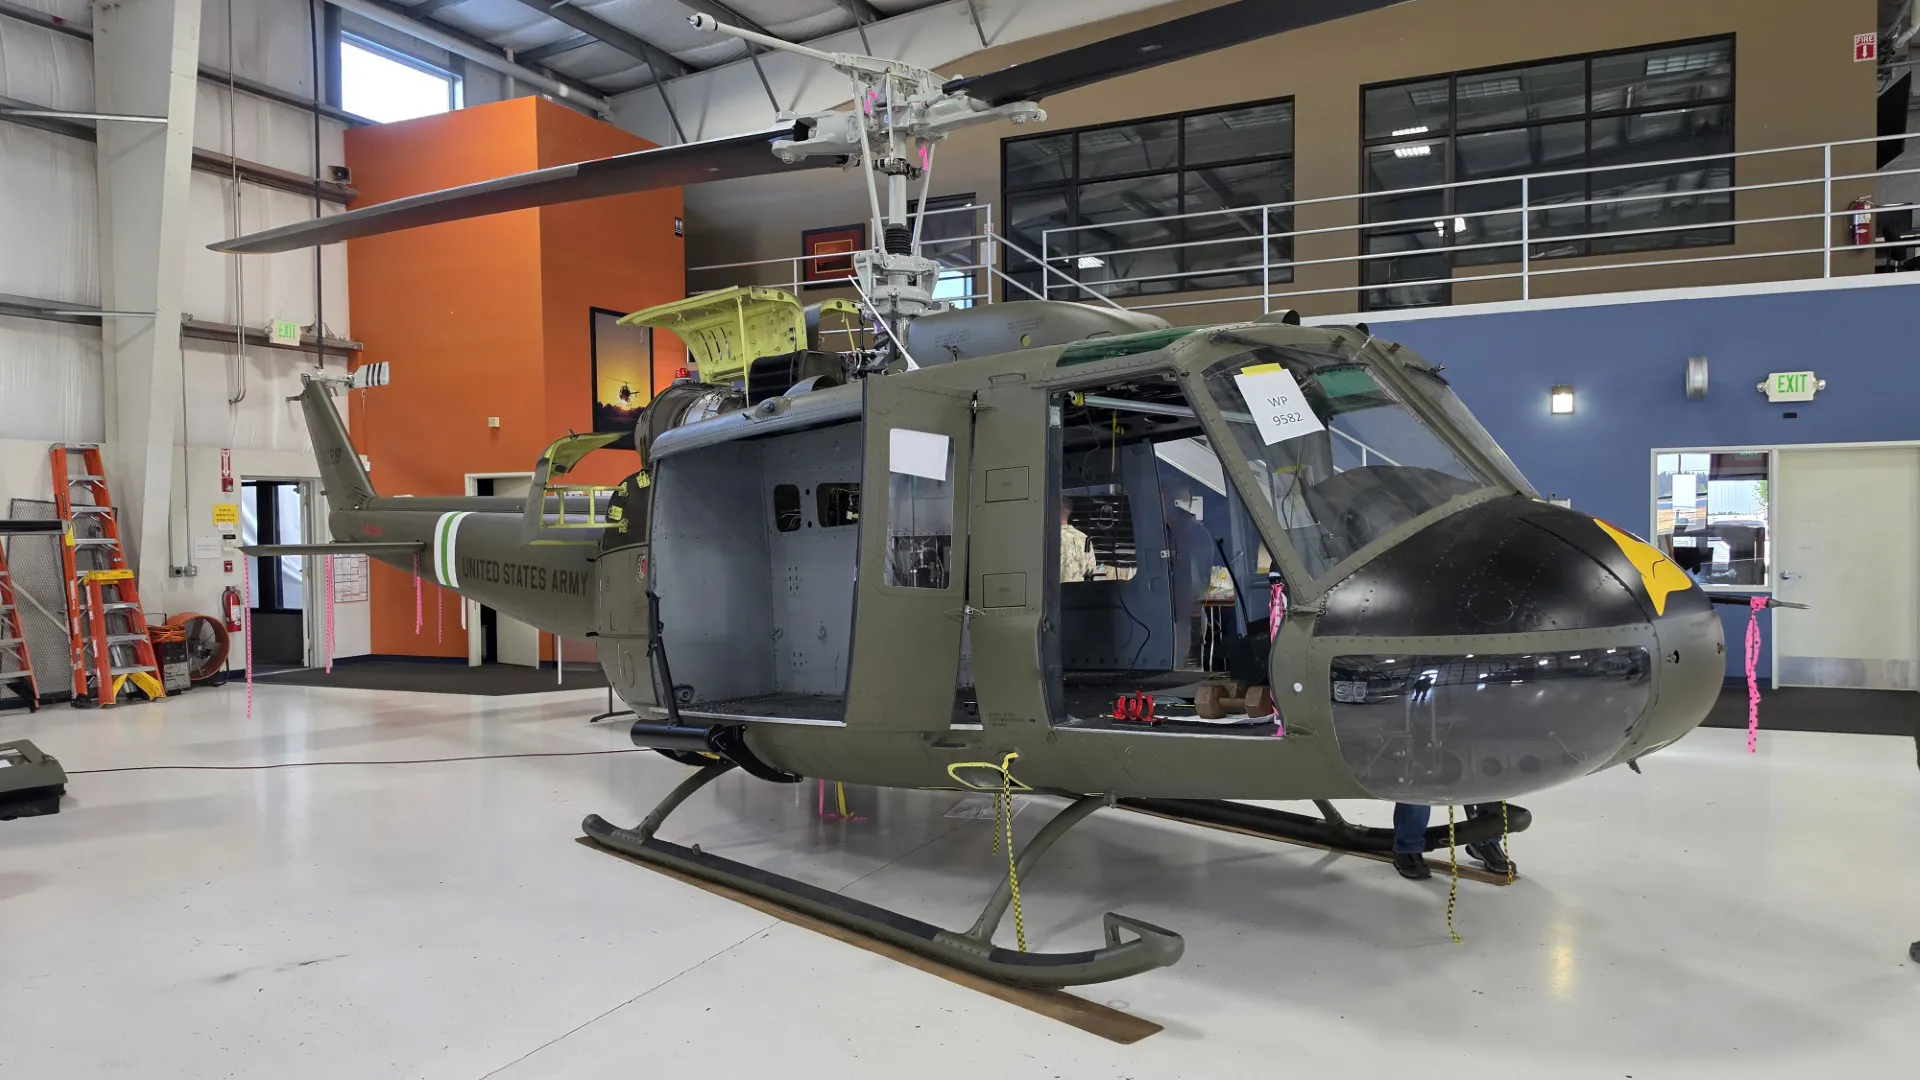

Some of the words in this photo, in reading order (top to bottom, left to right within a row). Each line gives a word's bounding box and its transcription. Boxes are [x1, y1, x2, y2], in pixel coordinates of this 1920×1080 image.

[1856, 34, 1875, 43] FIRE
[278, 321, 297, 339] EXIT
[1777, 374, 1808, 393] EXIT
[1267, 395, 1288, 407] WP
[1272, 412, 1304, 426] 9582
[462, 557, 500, 583] UNITED
[503, 562, 547, 590] STATES
[551, 569, 588, 597] ARMY
